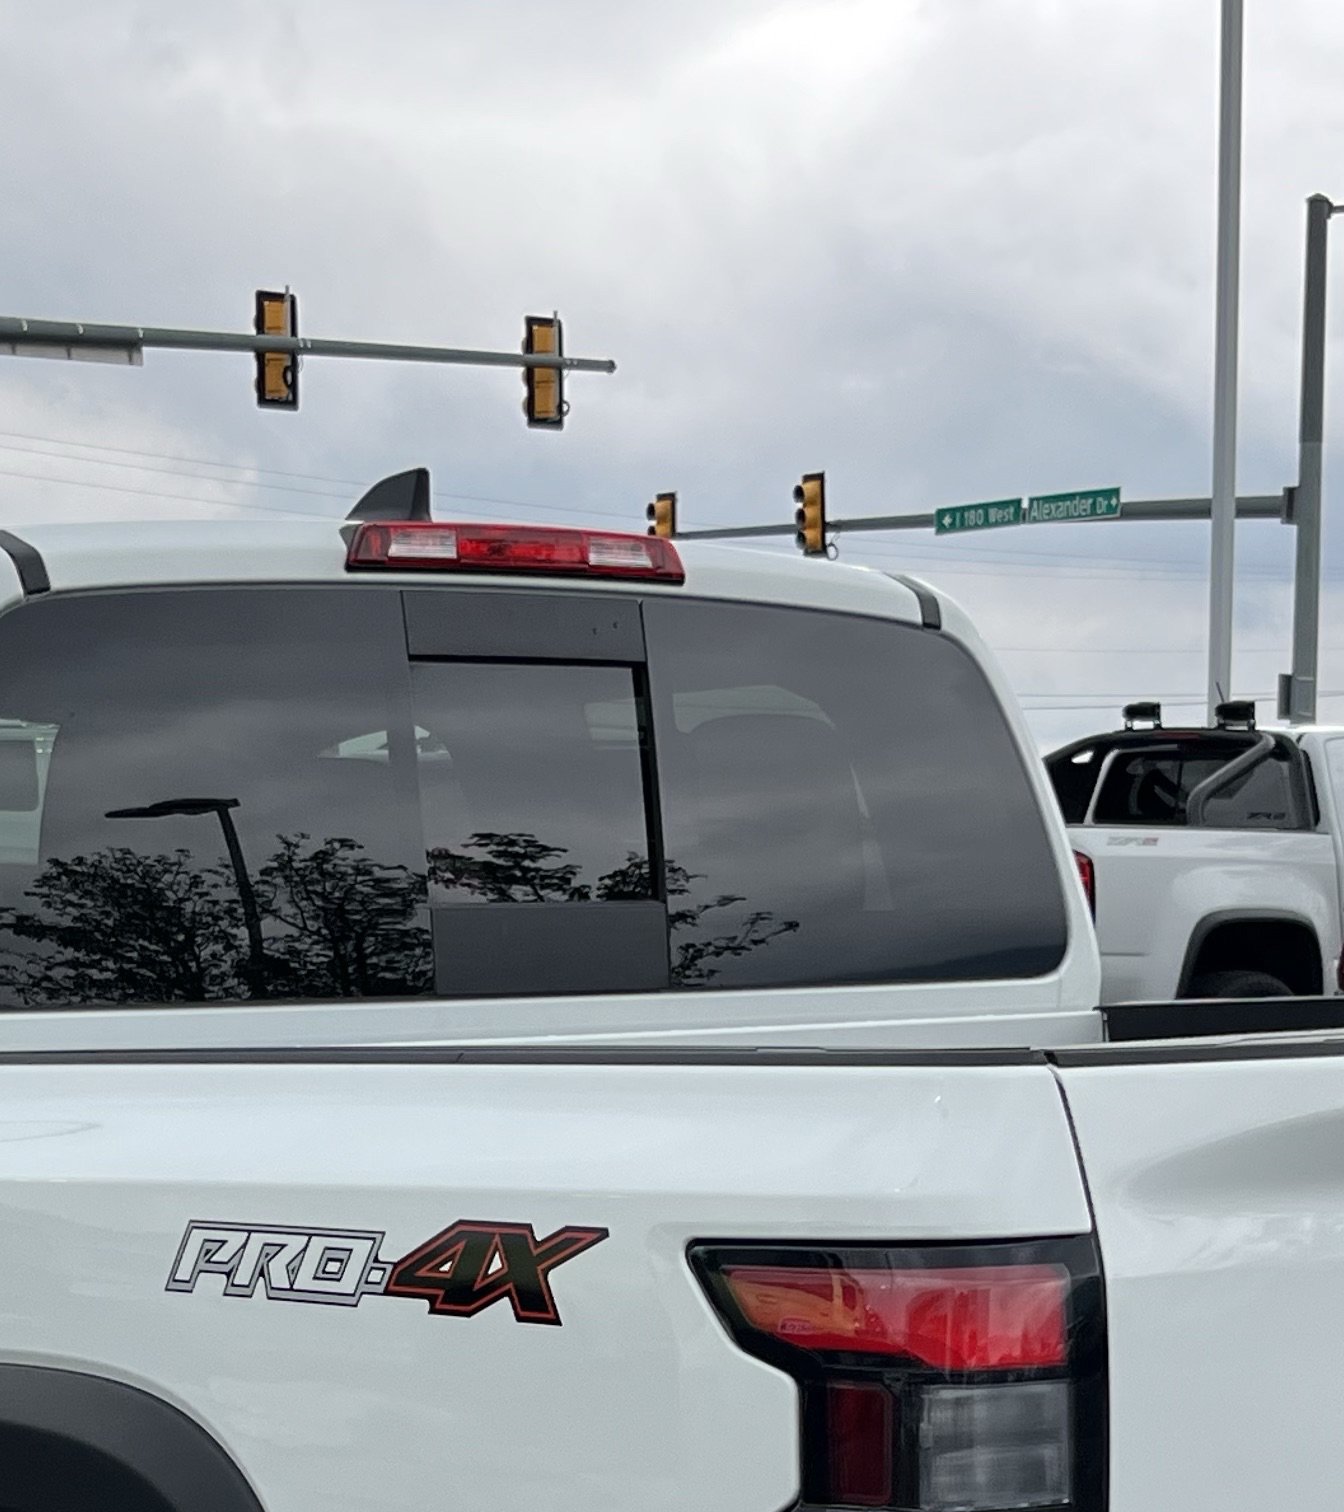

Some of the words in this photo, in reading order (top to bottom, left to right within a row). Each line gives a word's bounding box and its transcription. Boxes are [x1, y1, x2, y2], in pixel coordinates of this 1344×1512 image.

[964, 509, 983, 527] 180
[988, 505, 1015, 523] West
[1030, 496, 1093, 521] Alexander
[1096, 499, 1108, 514] Dr
[165, 1219, 610, 1327] PRO-4X
